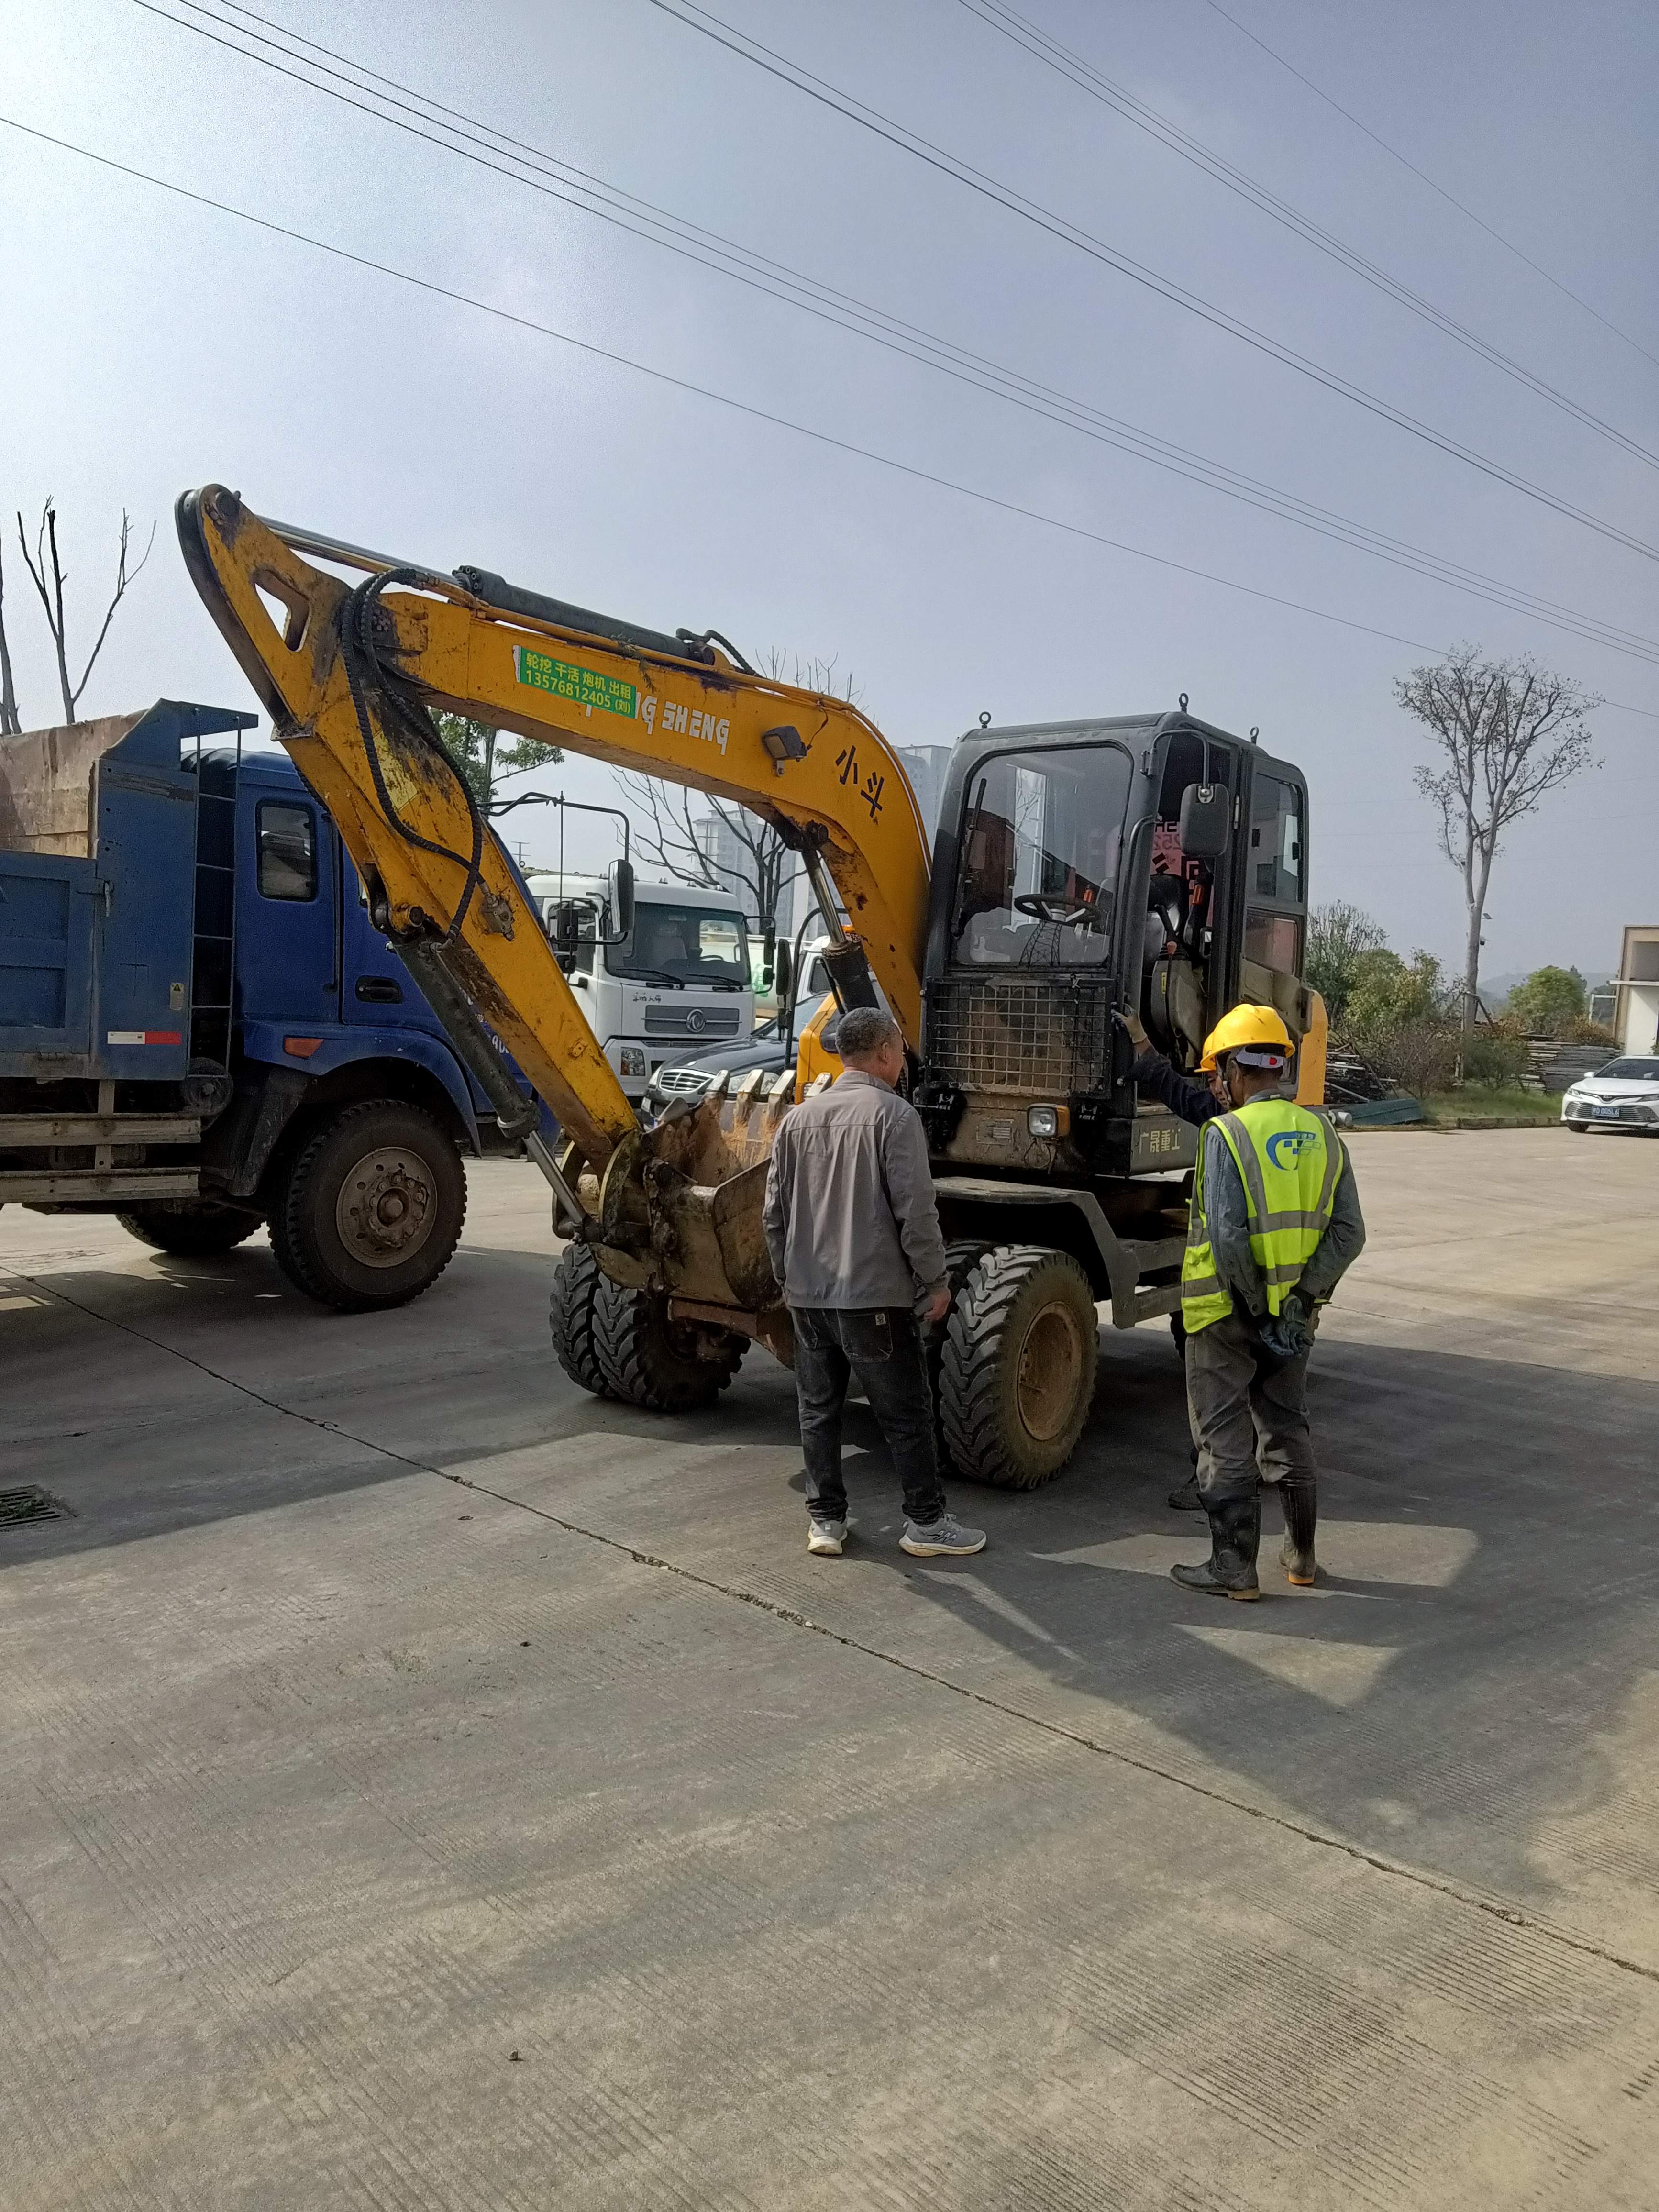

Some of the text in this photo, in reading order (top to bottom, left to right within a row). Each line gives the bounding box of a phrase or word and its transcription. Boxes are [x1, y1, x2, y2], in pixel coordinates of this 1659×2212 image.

[526, 653, 552, 674] 轮挖
[555, 662, 580, 683] 干活
[582, 671, 606, 691] 炮机
[609, 680, 631, 700] 出租
[526, 670, 611, 708] 13576812405
[661, 701, 730, 756] SHENG
